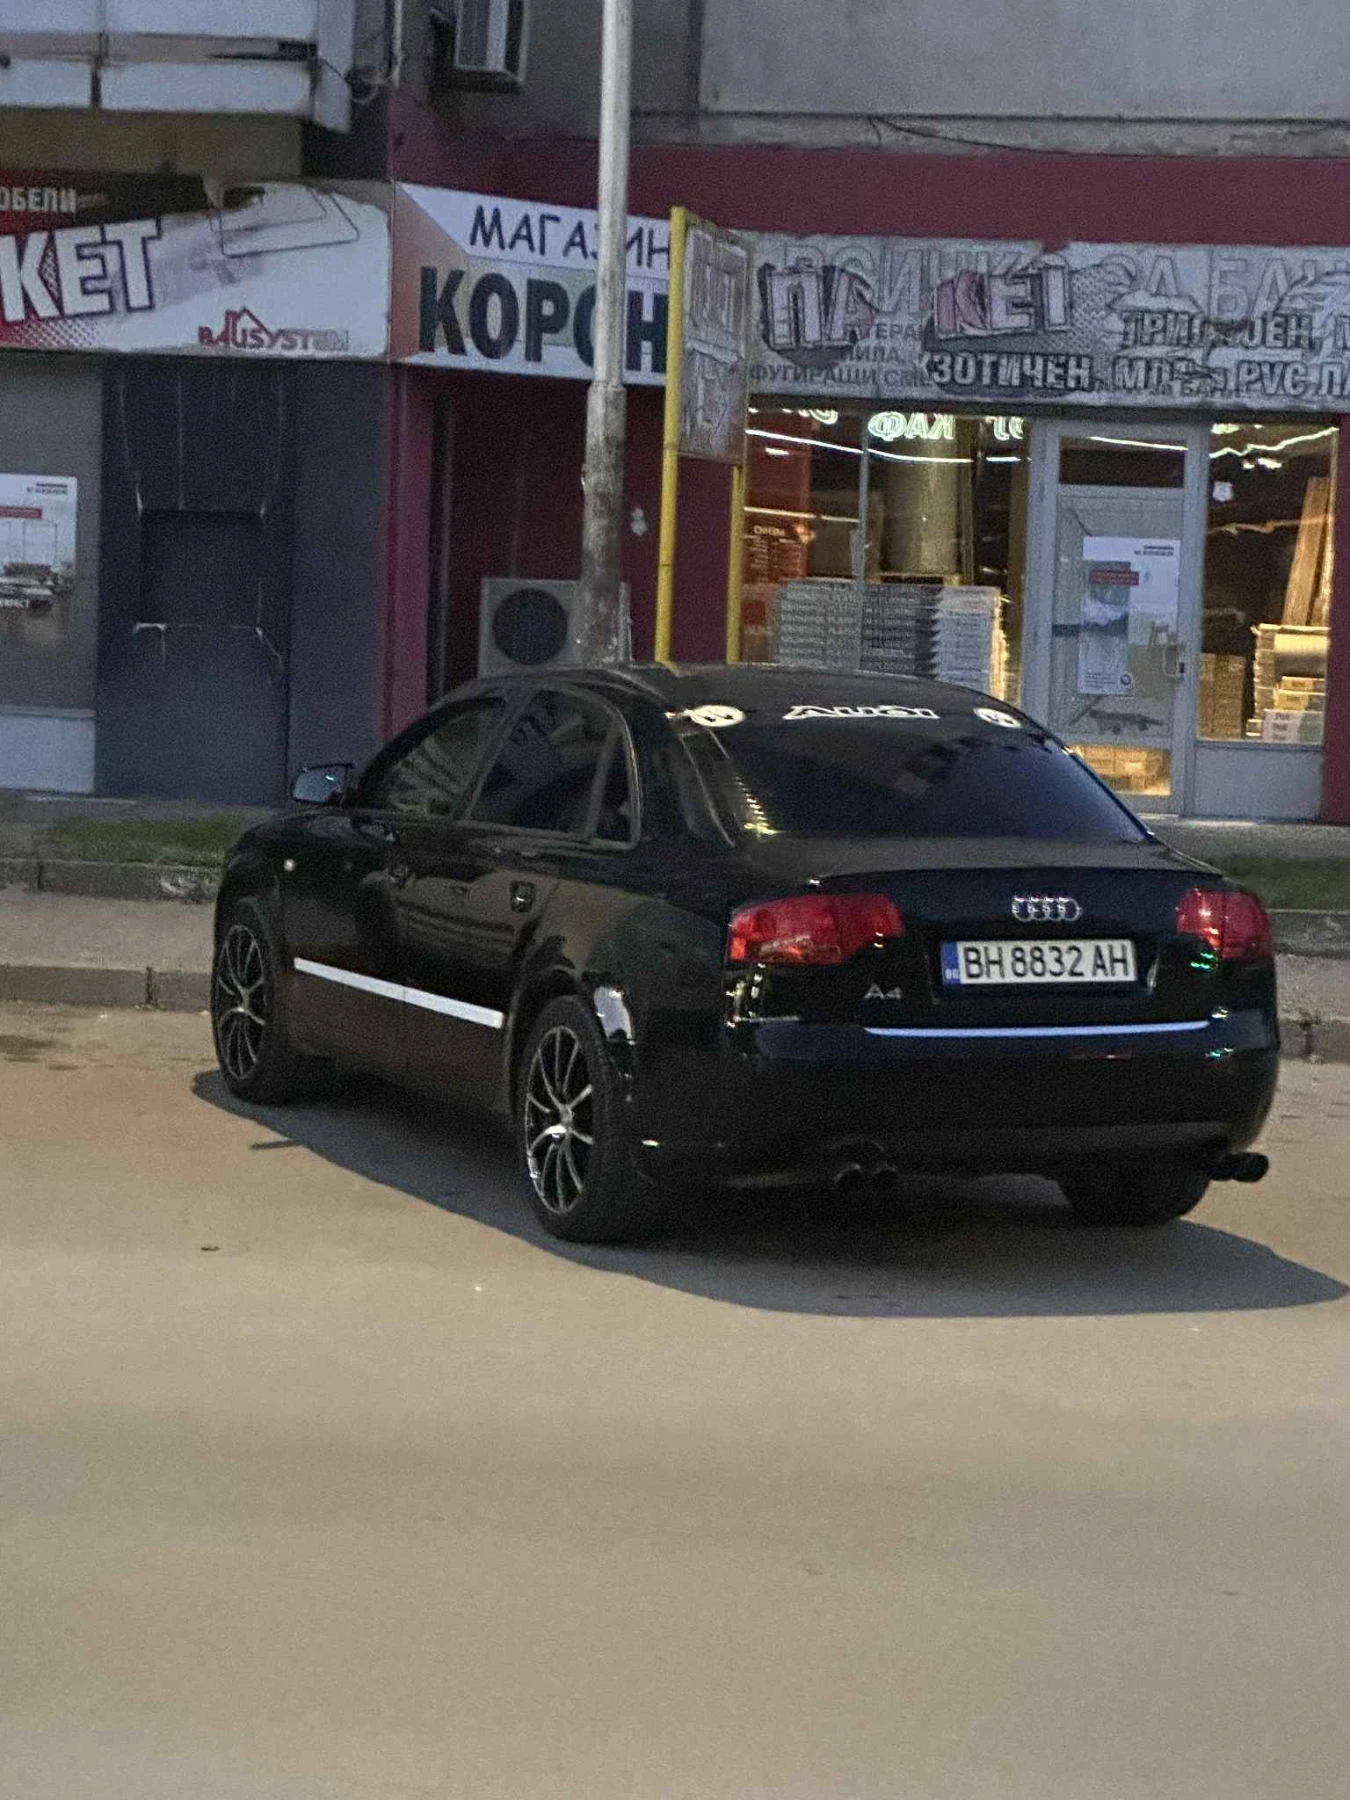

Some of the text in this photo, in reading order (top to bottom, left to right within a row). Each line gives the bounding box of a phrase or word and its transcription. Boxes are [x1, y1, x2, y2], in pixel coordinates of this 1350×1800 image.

[469, 204, 669, 269] МАГАИН
[419, 266, 669, 374] КОРН
[929, 351, 1093, 392] ЗОТИЧЕН
[1010, 944, 1084, 978] 8832
[864, 983, 902, 999] A4
